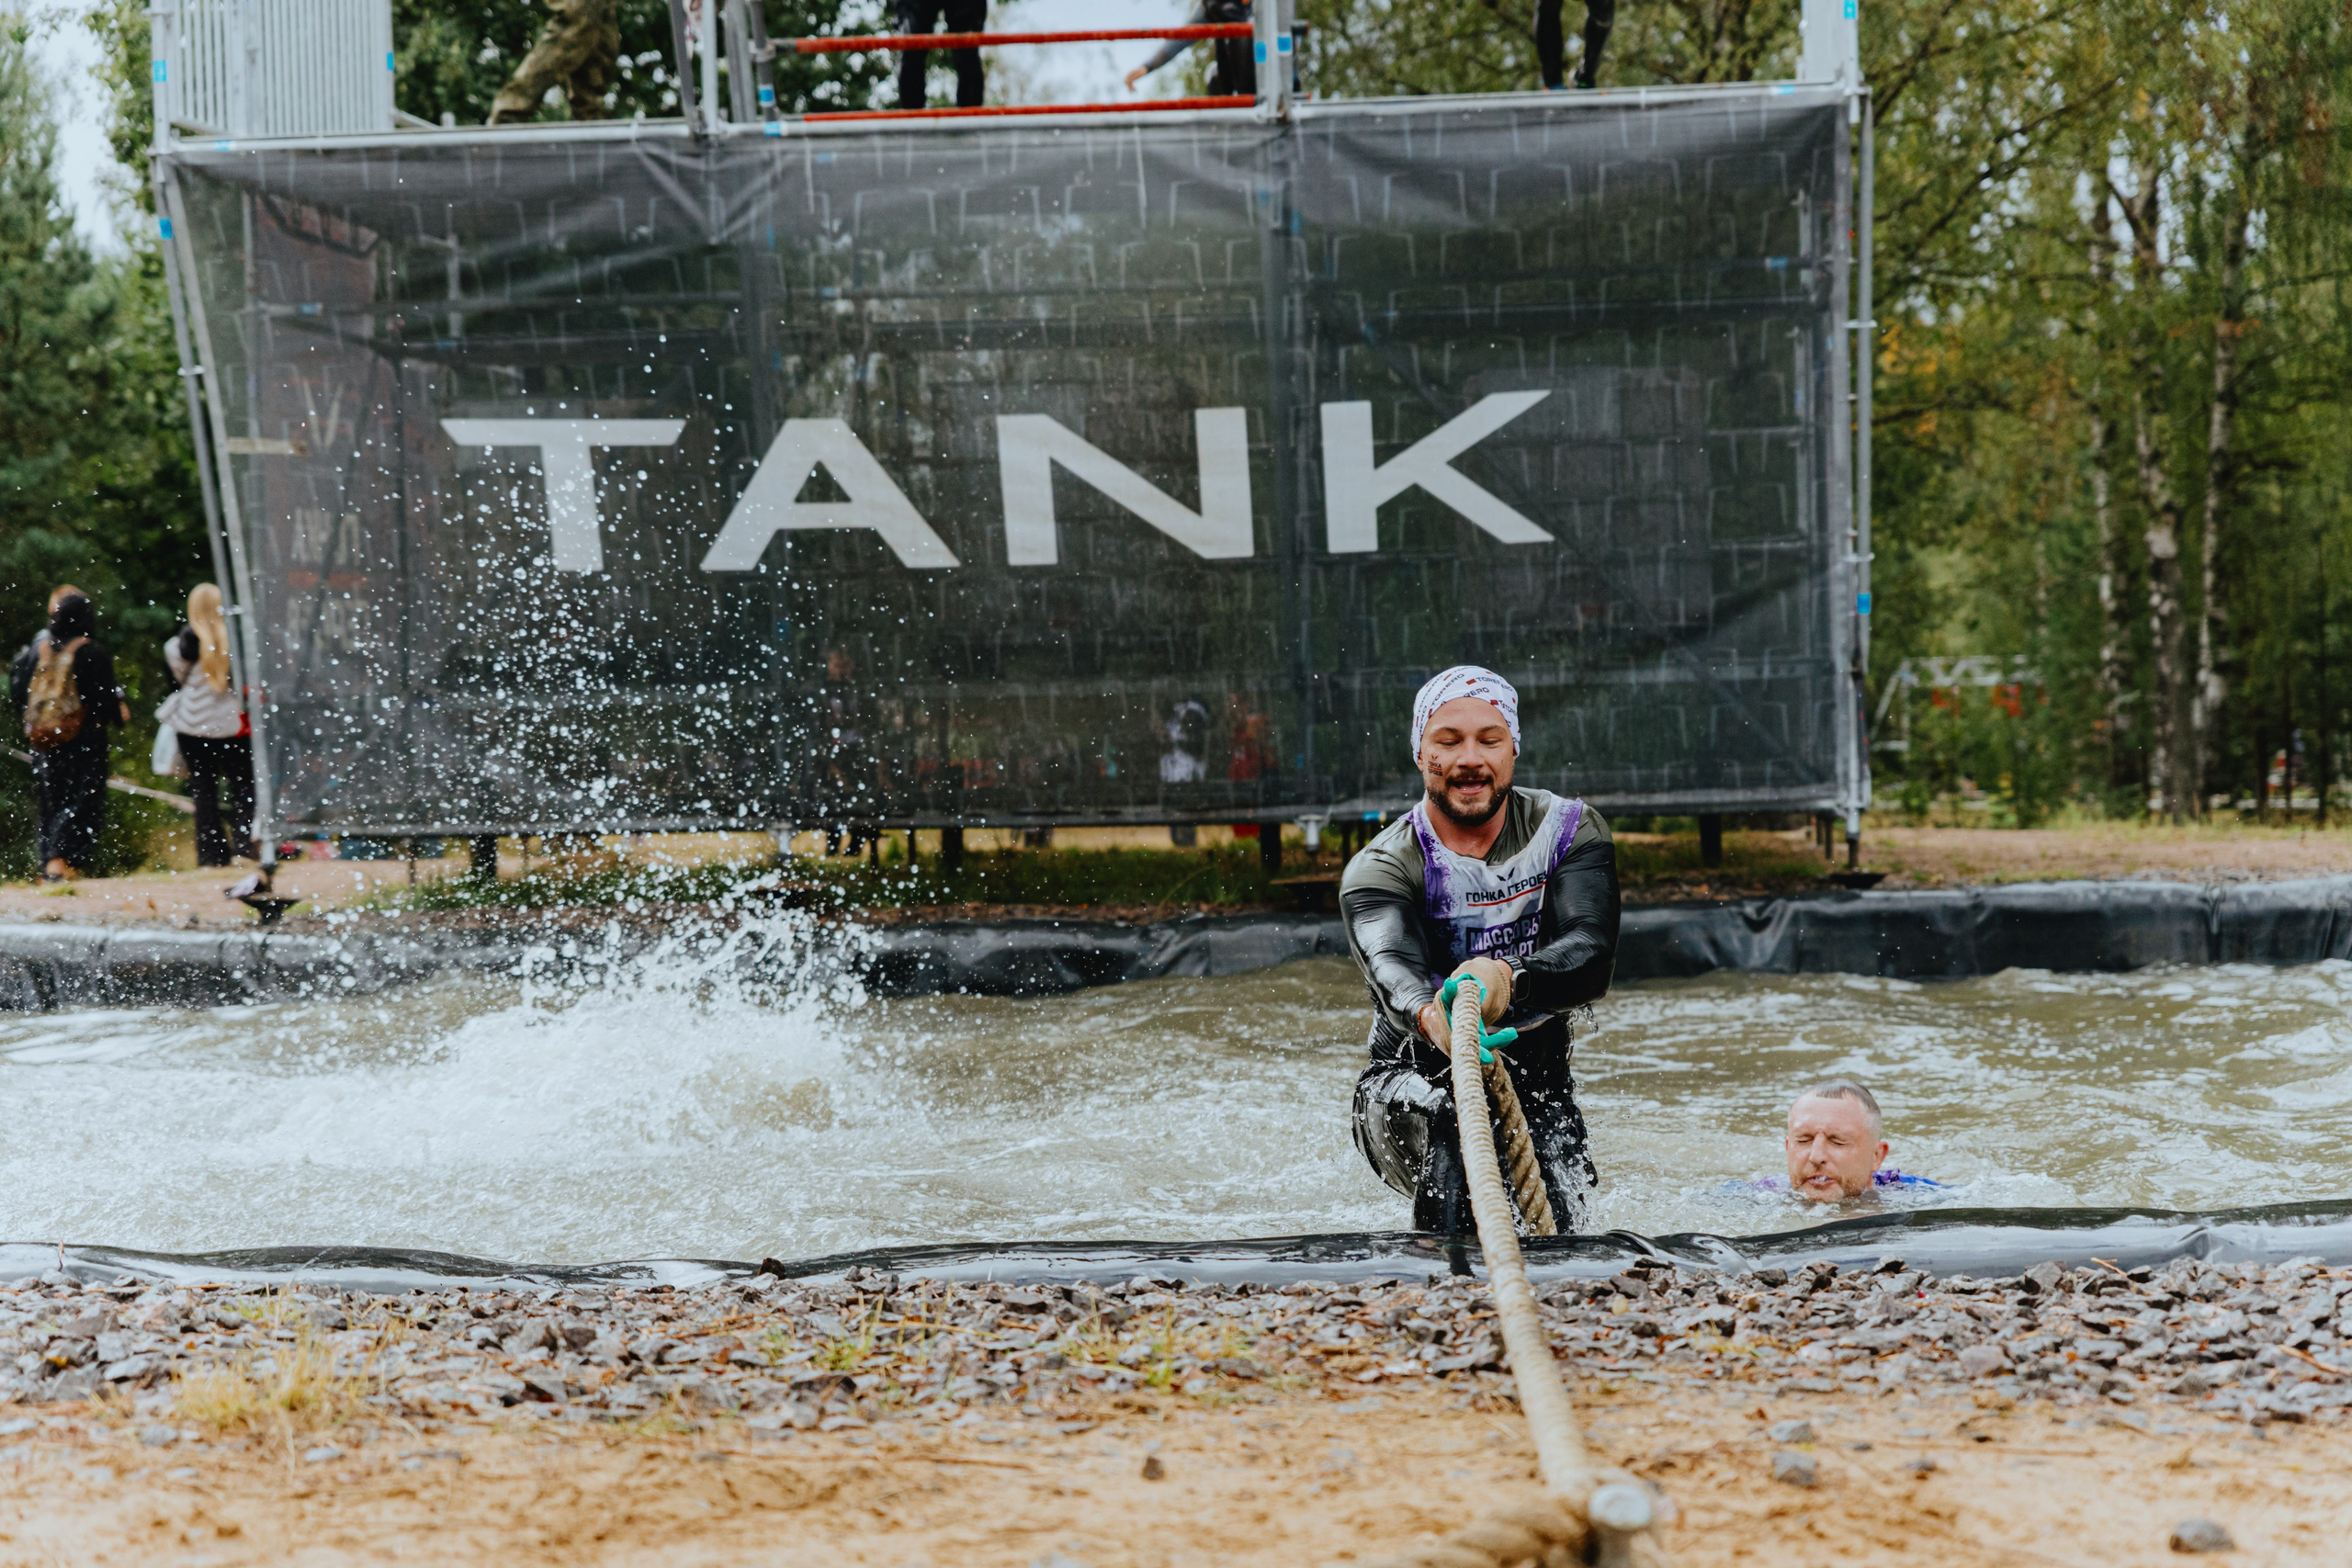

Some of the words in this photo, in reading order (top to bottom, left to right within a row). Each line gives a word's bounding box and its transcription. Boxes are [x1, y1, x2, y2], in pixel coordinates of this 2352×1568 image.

[441, 389, 1555, 572] TANK
[1430, 673, 1465, 706] TORERO
[1465, 889, 1506, 902] ГОНКА
